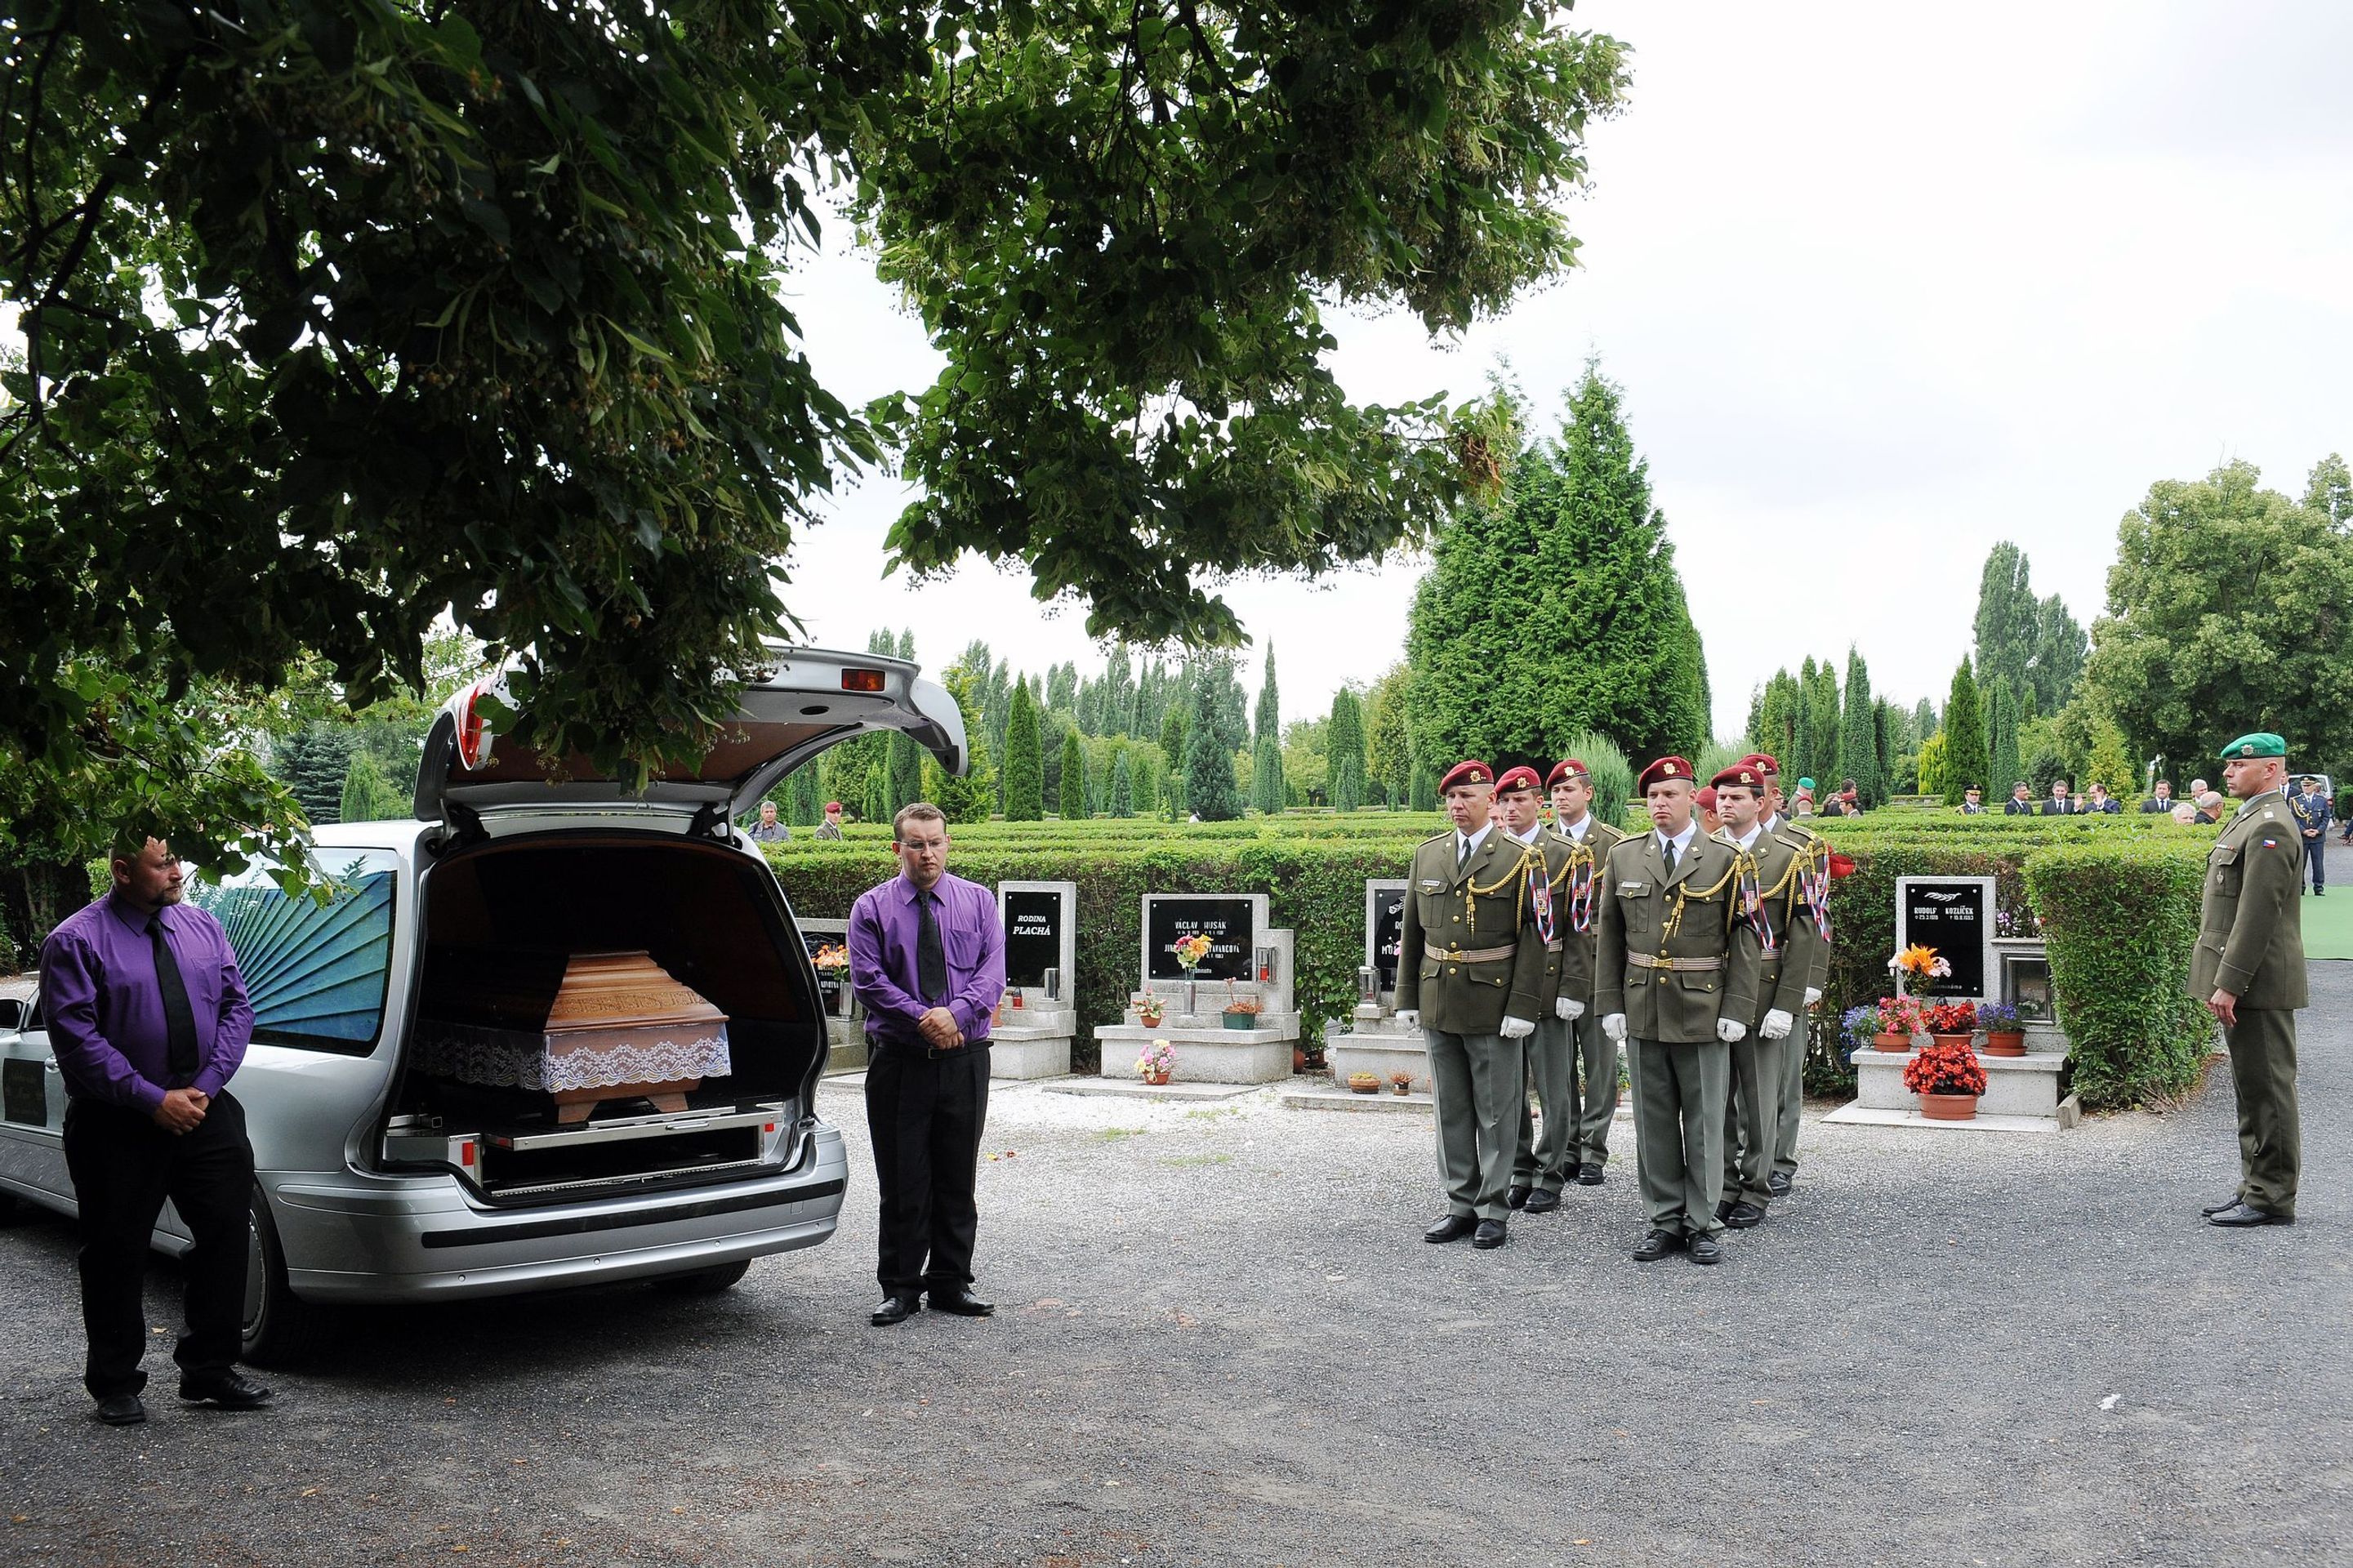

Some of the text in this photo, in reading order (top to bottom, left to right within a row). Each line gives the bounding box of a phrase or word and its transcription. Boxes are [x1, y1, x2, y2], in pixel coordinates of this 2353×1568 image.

[1914, 906, 1937, 915] RUDOLF
[1018, 915, 1046, 924] RODINA
[1174, 918, 1227, 929] VÁCLAV HUSÁK
[1012, 924, 1051, 936] PLACHÁ
